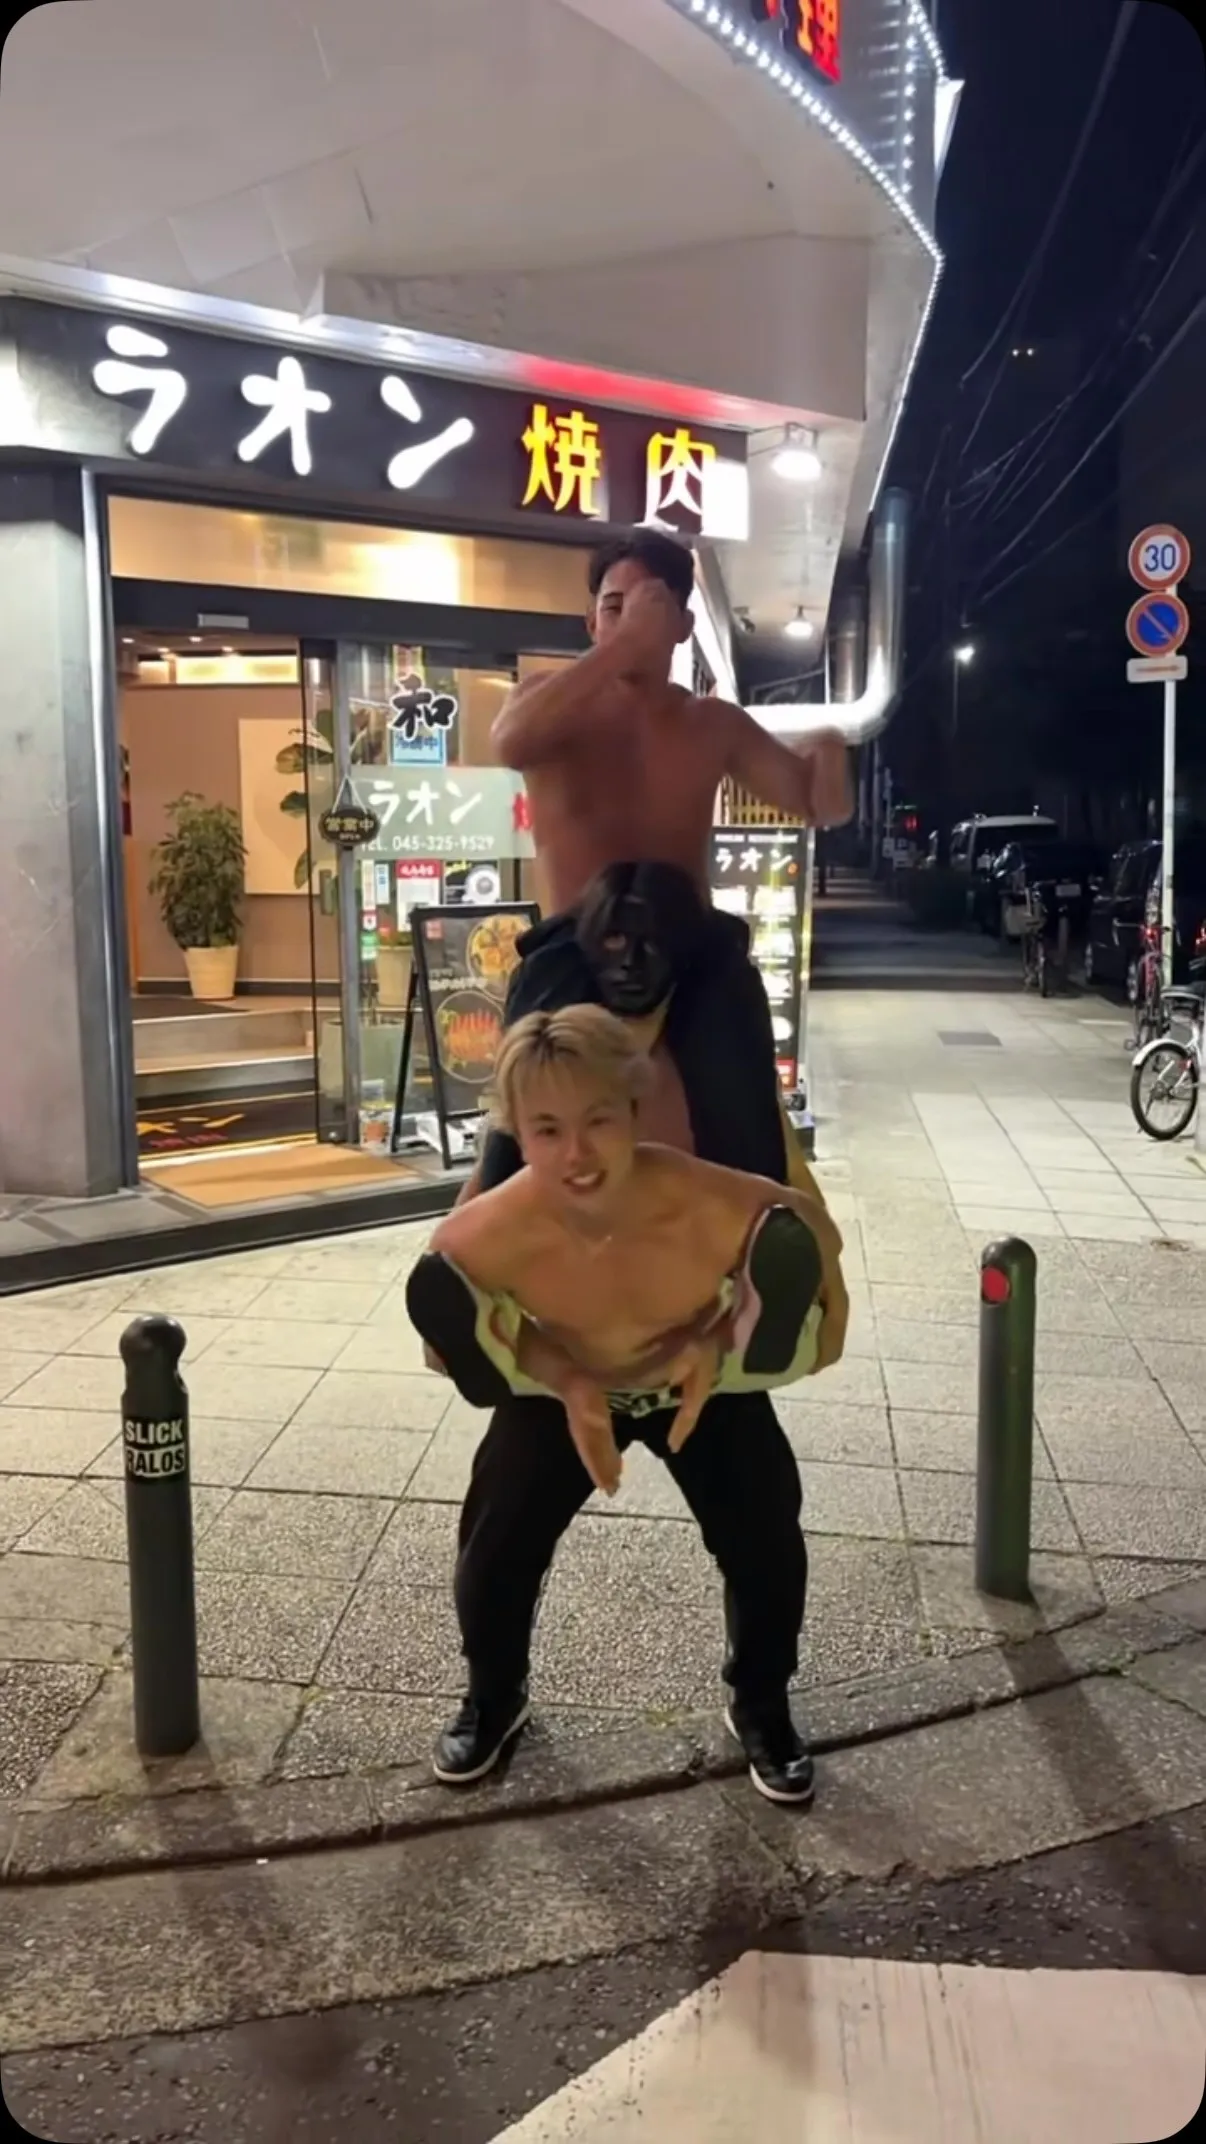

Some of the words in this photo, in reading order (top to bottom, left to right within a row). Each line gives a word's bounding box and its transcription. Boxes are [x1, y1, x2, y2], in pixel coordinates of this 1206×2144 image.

[92, 324, 475, 490] ラオン
[521, 403, 717, 531] 焼肉
[1144, 543, 1176, 572] 30
[368, 780, 483, 825] ラオン
[715, 847, 793, 873] ラオン
[124, 1419, 183, 1445] SLICK
